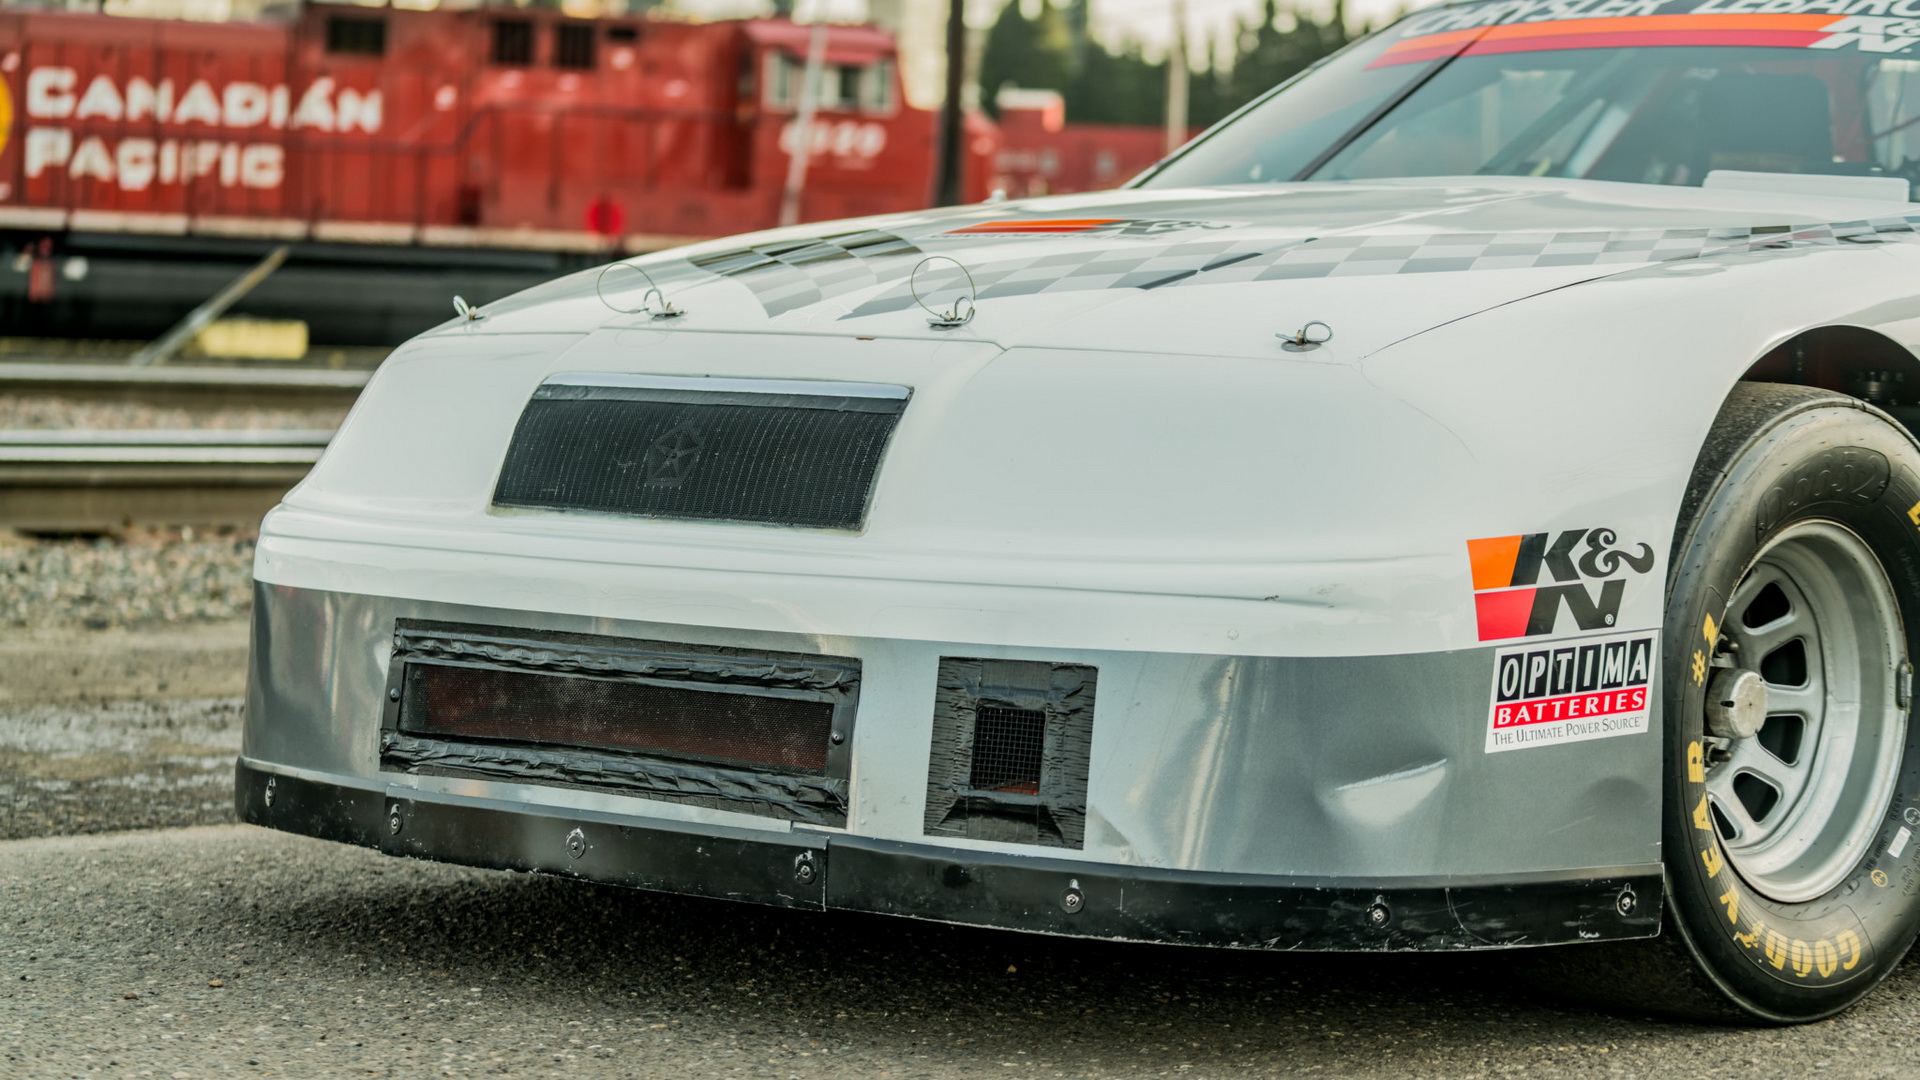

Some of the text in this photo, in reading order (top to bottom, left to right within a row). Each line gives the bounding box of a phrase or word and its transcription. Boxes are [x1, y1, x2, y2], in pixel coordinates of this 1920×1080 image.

[26, 66, 383, 133] CANADIAN
[24, 126, 285, 191] PACIFIC
[1499, 641, 1650, 699] OPTIMA
[1497, 690, 1645, 726] BATTERIES
[1688, 741, 1861, 978] GOODYEAR
